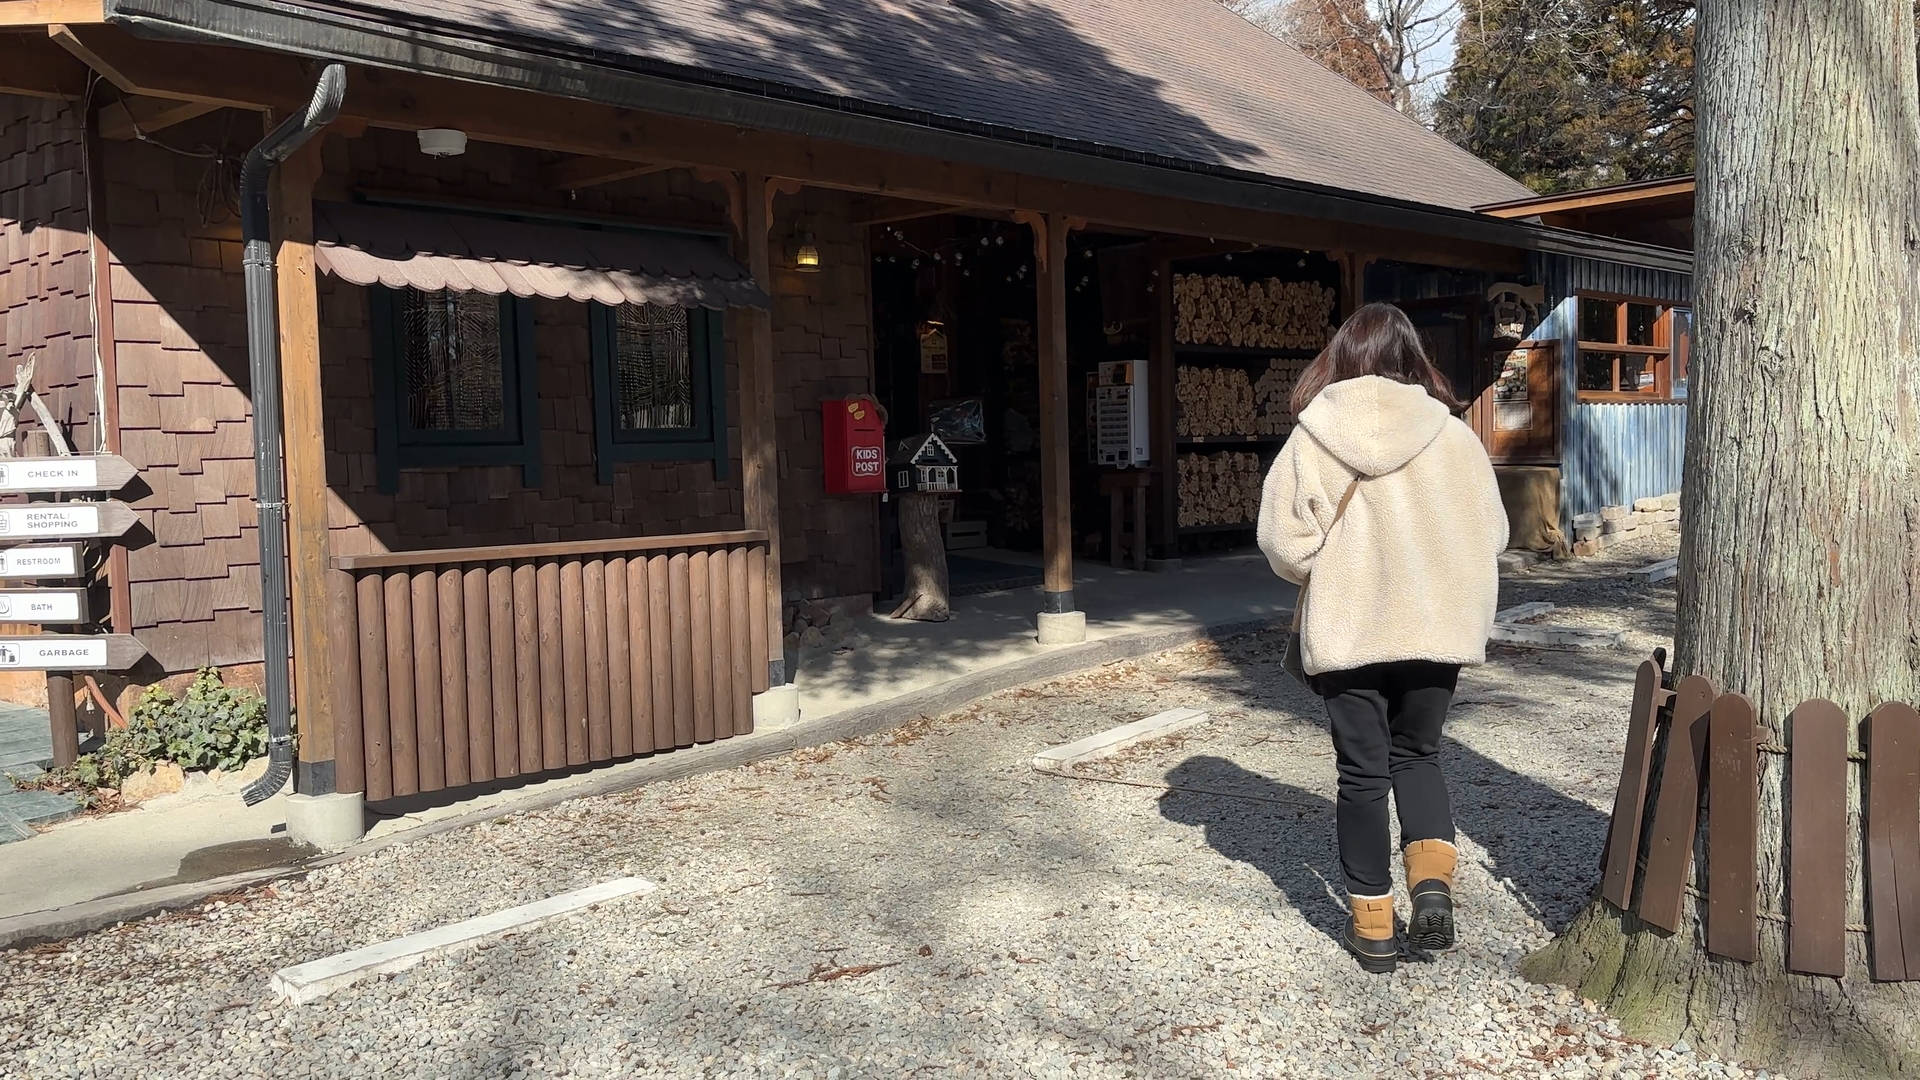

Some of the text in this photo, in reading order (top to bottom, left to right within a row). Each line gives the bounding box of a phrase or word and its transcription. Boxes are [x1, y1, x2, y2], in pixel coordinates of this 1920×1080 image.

[856, 449, 878, 460] KIDS
[855, 462, 879, 472] POST
[27, 470, 64, 478] CHECK
[27, 521, 78, 529] SHOPPING
[16, 557, 61, 566] RESTROOM
[31, 603, 53, 611] BATH
[39, 648, 89, 657] GARBAGE
